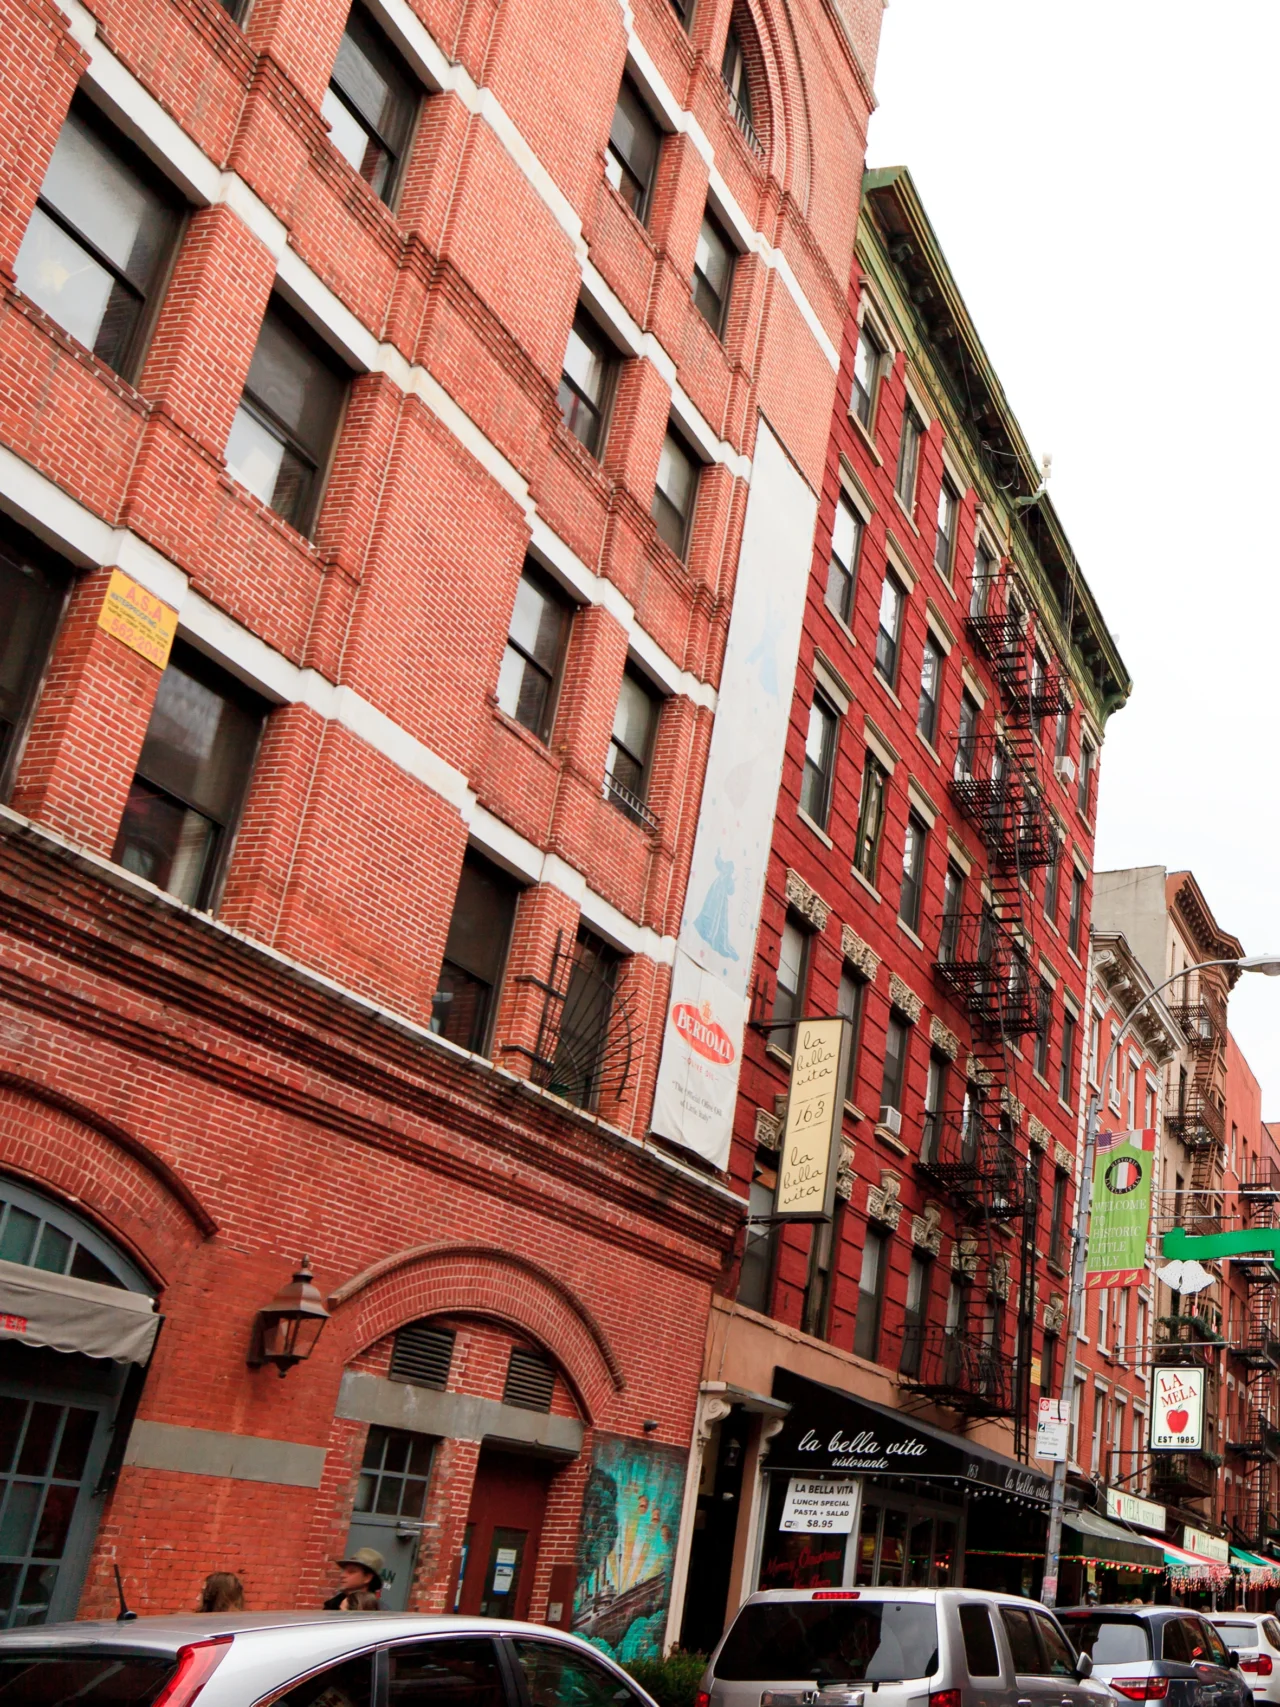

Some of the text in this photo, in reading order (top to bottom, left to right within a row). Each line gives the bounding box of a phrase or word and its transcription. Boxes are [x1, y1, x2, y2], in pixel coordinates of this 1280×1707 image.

[677, 1007, 731, 1060] BERTOLLI
[803, 1030, 827, 1050] la
[795, 1049, 836, 1073] bella
[796, 1066, 833, 1087] vita
[795, 1100, 826, 1127] 163
[790, 1146, 814, 1167] la
[783, 1168, 824, 1190] bella
[783, 1184, 820, 1205] vita
[1094, 1199, 1147, 1213] WELCOME
[1094, 1216, 1106, 1227] TO
[1093, 1226, 1141, 1239] HISTORIC
[1091, 1241, 1127, 1254] LITTLE
[1089, 1255, 1120, 1268] ITALY
[1160, 1373, 1184, 1393] LA
[1160, 1385, 1197, 1408] MELA
[798, 1429, 927, 1457] la bella vita
[1177, 1436, 1195, 1444] 1985
[831, 1456, 889, 1470] ristorante
[795, 1484, 853, 1495] LA BELLA VITA
[966, 1463, 1051, 1500] 163 la bella vita
[792, 1498, 818, 1506] LUNCH
[806, 1519, 833, 1528] $8.95
